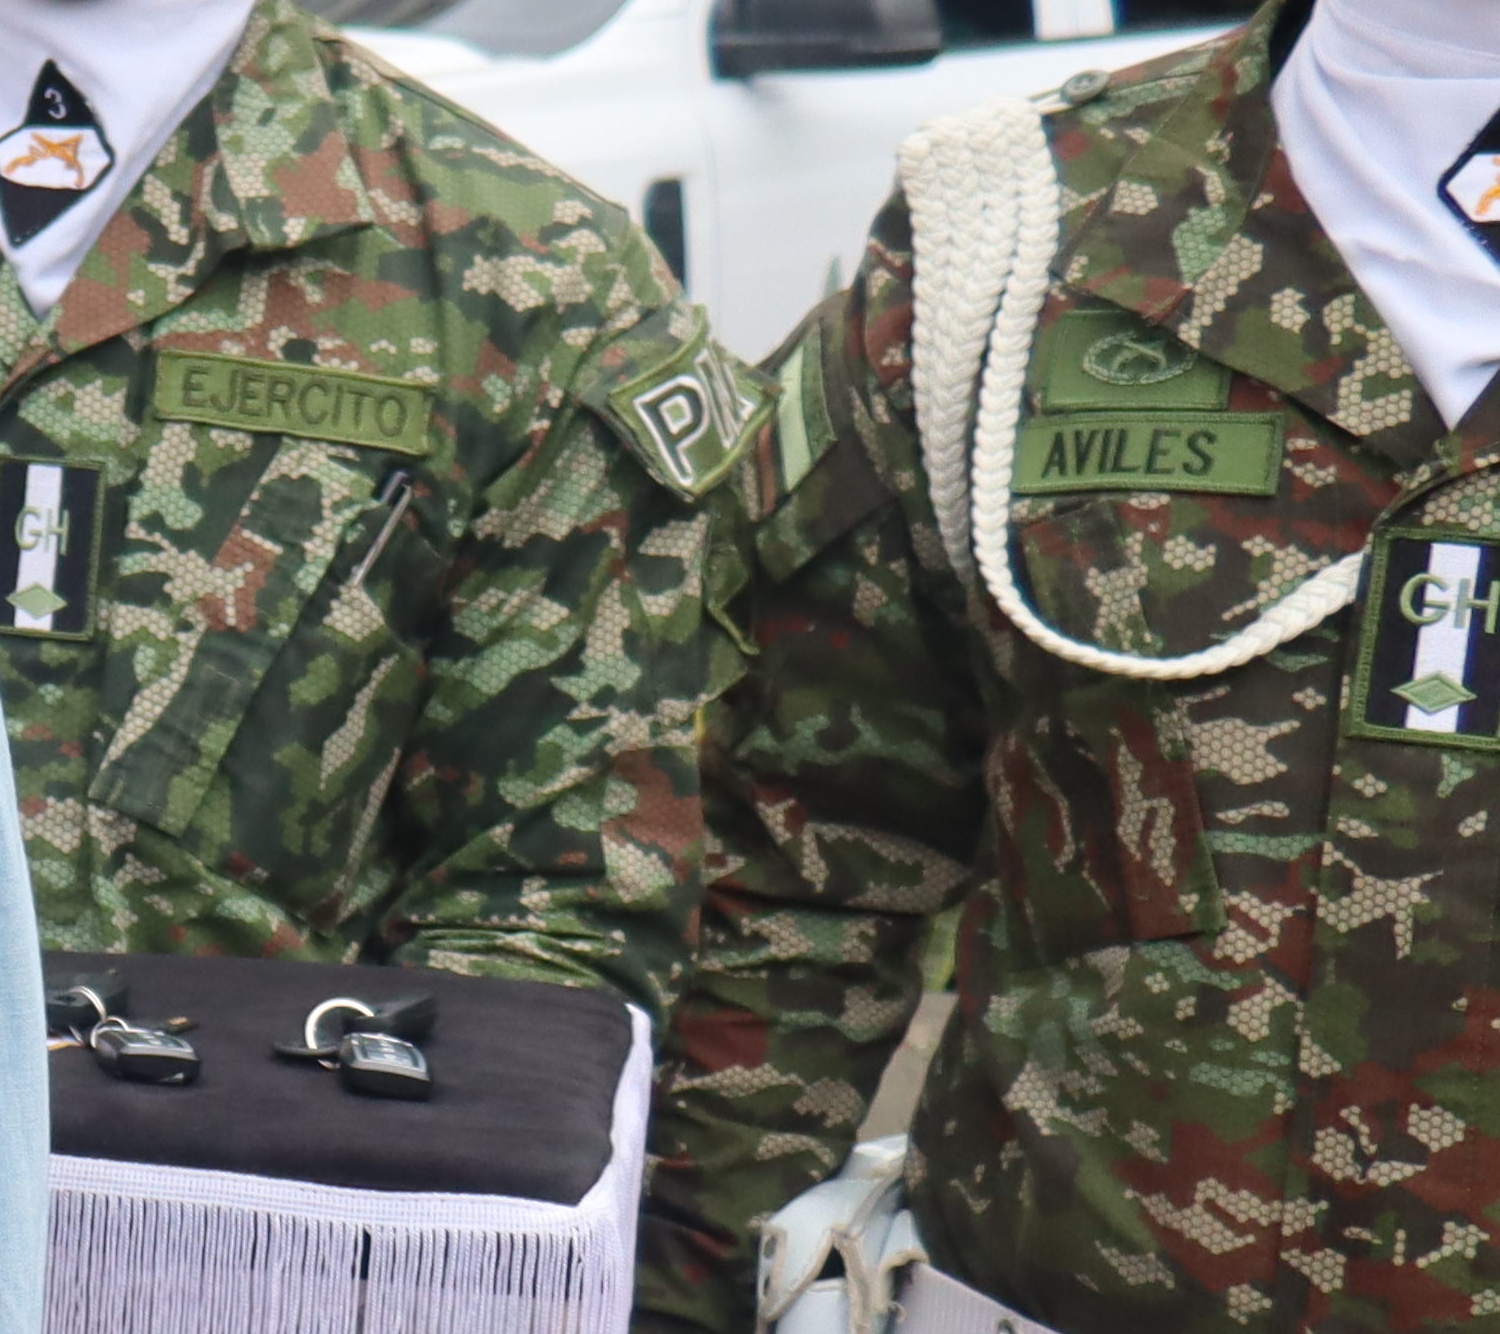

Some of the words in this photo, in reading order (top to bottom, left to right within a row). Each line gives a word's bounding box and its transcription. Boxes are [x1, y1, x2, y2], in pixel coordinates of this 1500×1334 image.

[43, 87, 67, 120] 3
[181, 367, 408, 438] EJERCITO
[1041, 428, 1218, 479] AVILES
[14, 506, 71, 556] GH
[1399, 572, 1500, 635] GH
